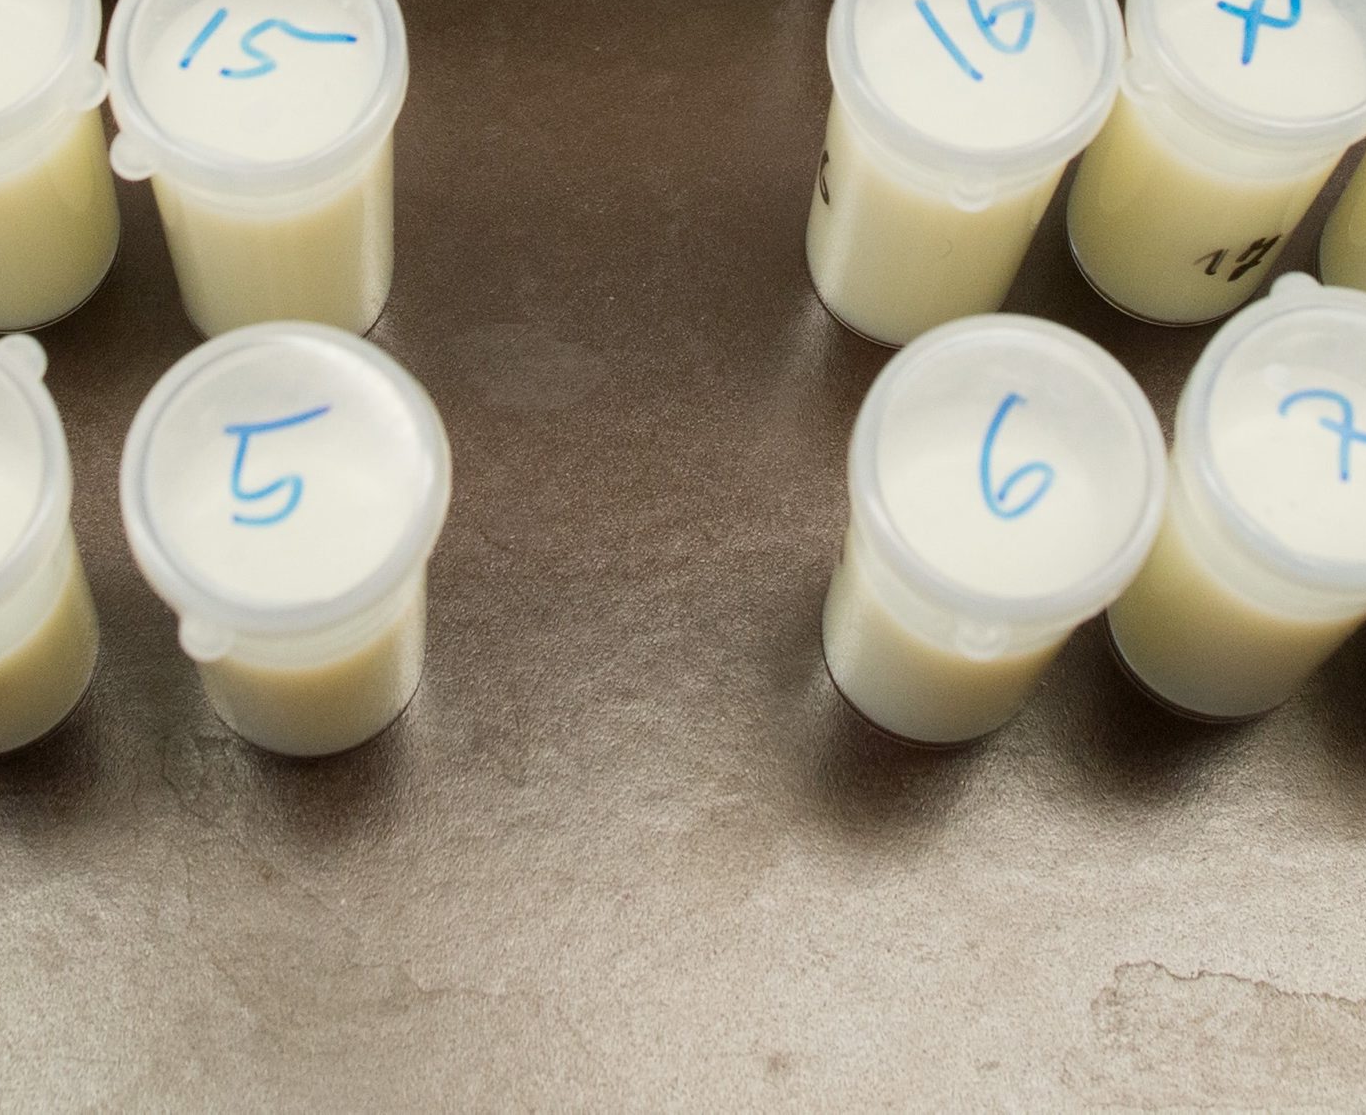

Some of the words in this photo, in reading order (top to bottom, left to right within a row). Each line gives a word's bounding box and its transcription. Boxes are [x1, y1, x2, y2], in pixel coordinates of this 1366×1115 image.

[178, 7, 358, 79] 15
[224, 406, 328, 527] 5
[978, 393, 1054, 520] 6
